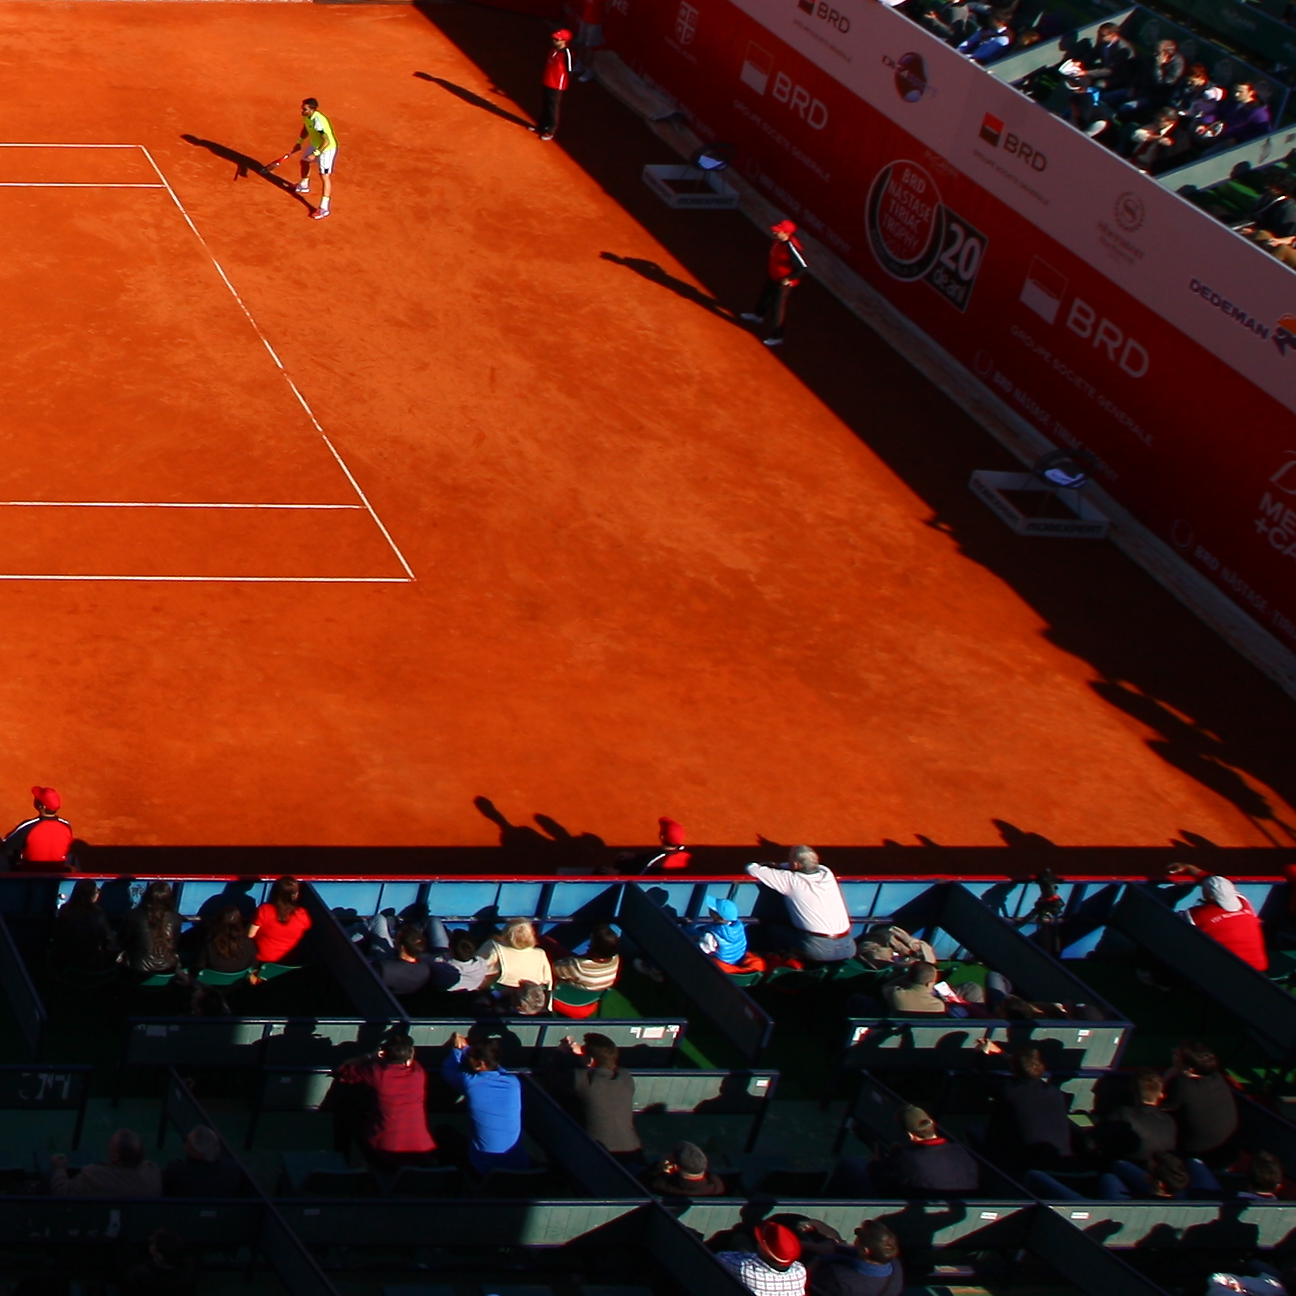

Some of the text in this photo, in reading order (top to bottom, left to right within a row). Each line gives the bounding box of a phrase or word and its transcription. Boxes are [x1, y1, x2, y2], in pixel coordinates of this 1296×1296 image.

[816, 2, 850, 34] BRD
[772, 70, 830, 131] BRD
[1004, 133, 1047, 172] BRD
[902, 167, 927, 195] BRD
[933, 267, 948, 288] de
[939, 222, 981, 282] 20
[1189, 277, 1270, 341] DEDEMAN
[1065, 296, 1151, 379] BRD
[1010, 324, 1052, 364] GROUPE
[1096, 392, 1155, 448] GENERALE
[1258, 490, 1296, 538] ME
